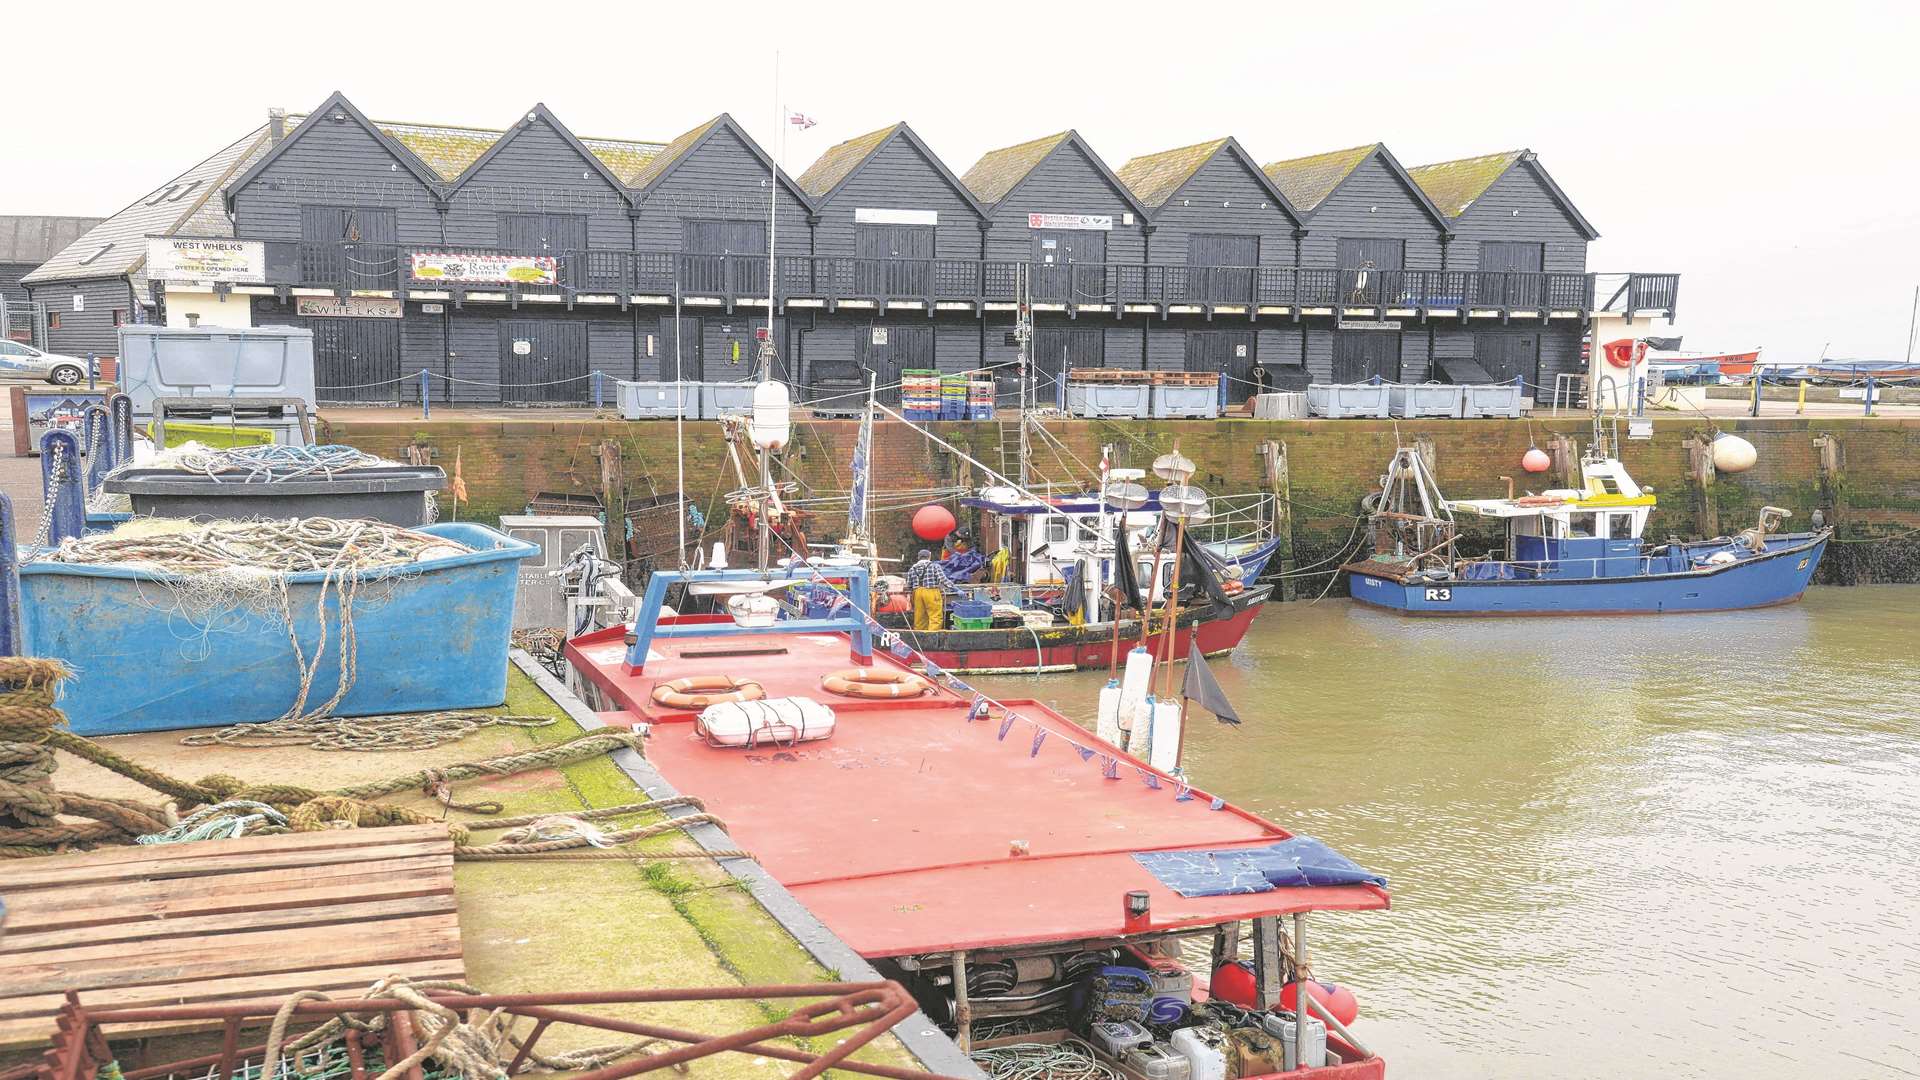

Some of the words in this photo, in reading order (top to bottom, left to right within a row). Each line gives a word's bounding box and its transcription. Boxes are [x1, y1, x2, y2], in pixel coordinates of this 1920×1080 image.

[173, 241, 200, 250] WEST
[202, 242, 243, 251] WHELKS
[469, 262, 500, 271] Rock
[317, 305, 387, 316] WHELKS
[1425, 588, 1451, 601] R3
